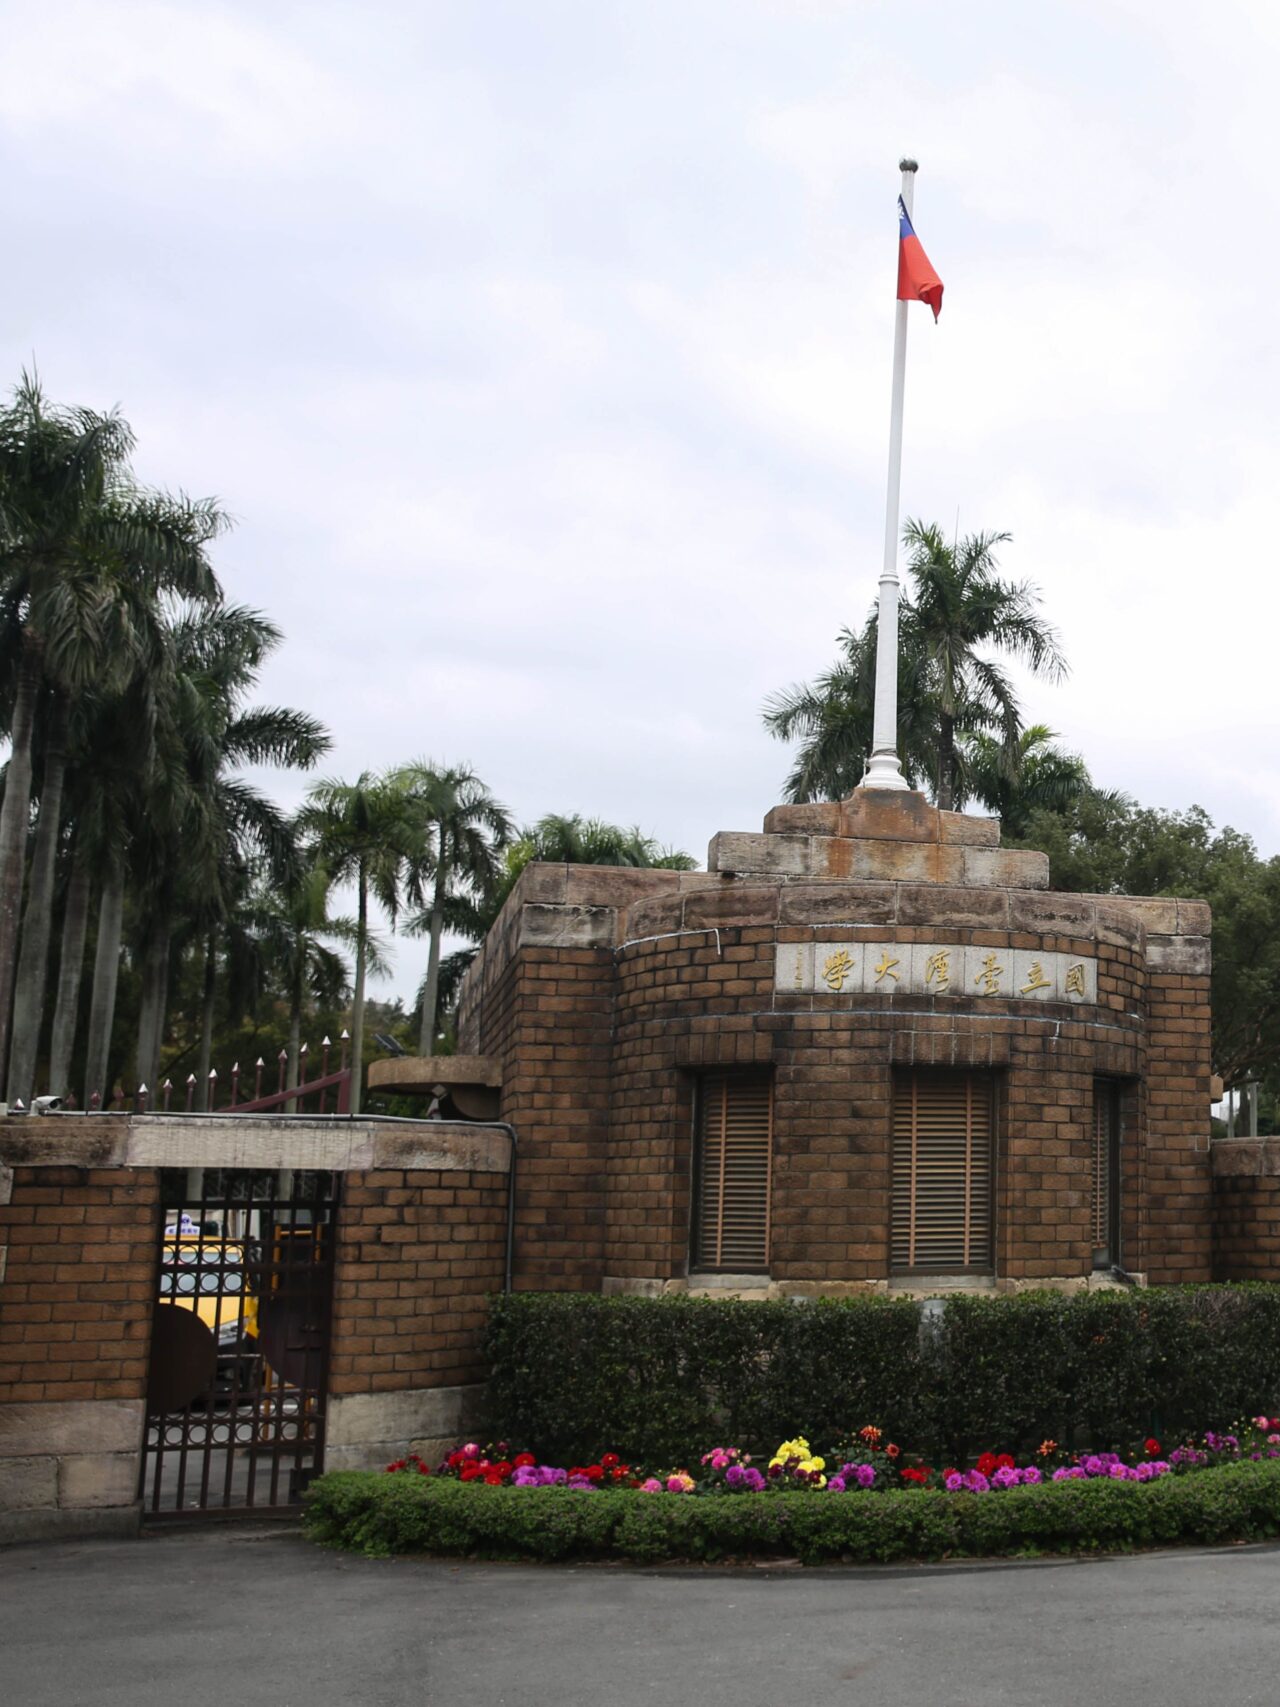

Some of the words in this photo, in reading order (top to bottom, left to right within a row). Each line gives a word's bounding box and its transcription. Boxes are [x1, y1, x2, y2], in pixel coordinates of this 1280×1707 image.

[821, 948, 1086, 998] 國立臺灣大學
